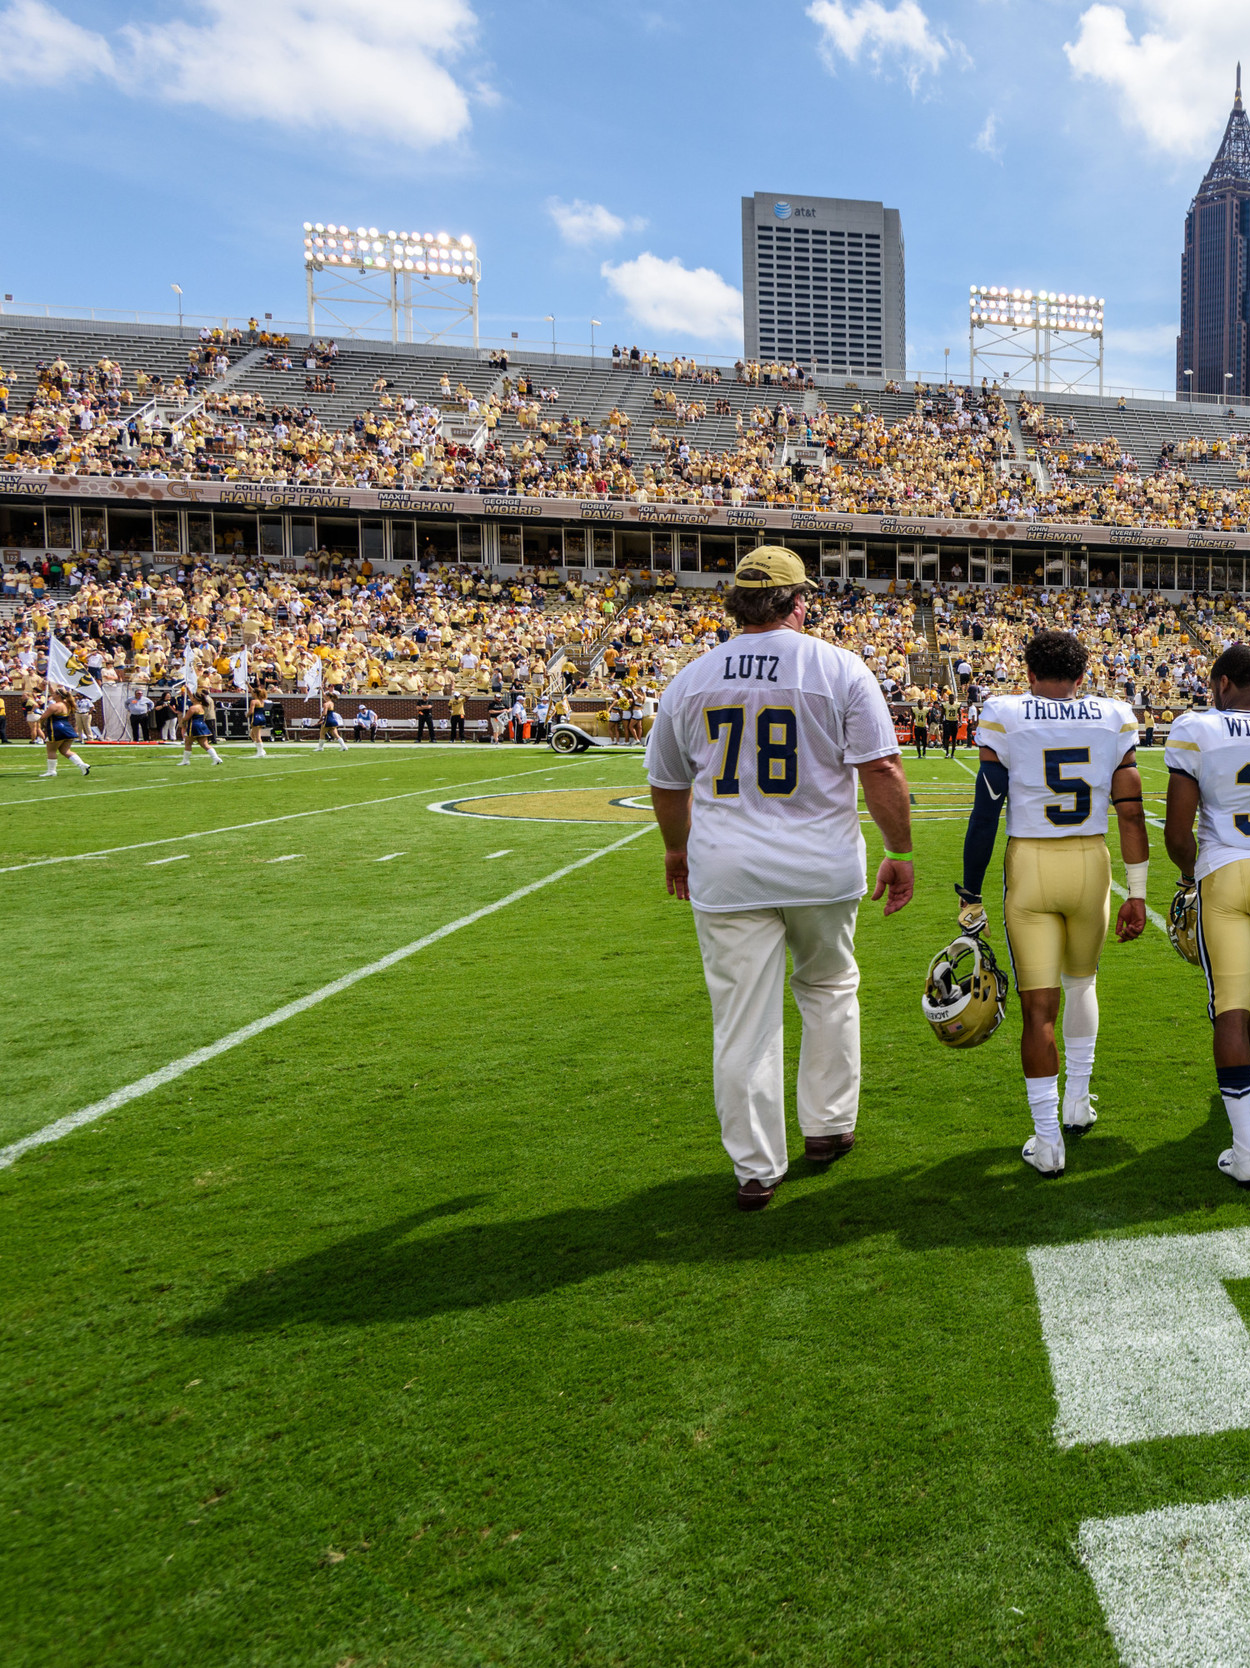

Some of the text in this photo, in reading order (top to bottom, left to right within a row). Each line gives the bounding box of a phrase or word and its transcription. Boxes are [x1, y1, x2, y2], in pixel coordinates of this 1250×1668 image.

[794, 207, 816, 218] at&t
[235, 484, 333, 495] COLLEGE FOOTBALL
[220, 491, 351, 507] HALL OF FAME
[483, 498, 521, 506] GEORGE
[380, 500, 454, 512] BAUGHAN
[484, 505, 542, 515] MORRIS
[580, 502, 612, 510] BOBBY
[638, 505, 655, 513] JOE
[581, 510, 624, 519] DAVIS
[638, 512, 709, 524] HAMILTON
[792, 513, 816, 521] BUCK
[728, 517, 766, 526] PUND
[792, 520, 853, 531] FLOWERS
[881, 525, 925, 534] GUYON
[1026, 532, 1082, 542] HEISMAN
[1110, 536, 1168, 545] STRUPPER
[1187, 539, 1236, 549] FINCHER
[723, 655, 779, 682] LUTZ
[1022, 700, 1103, 720] THOMAS
[703, 704, 798, 798] 78
[1043, 746, 1093, 828] 5
